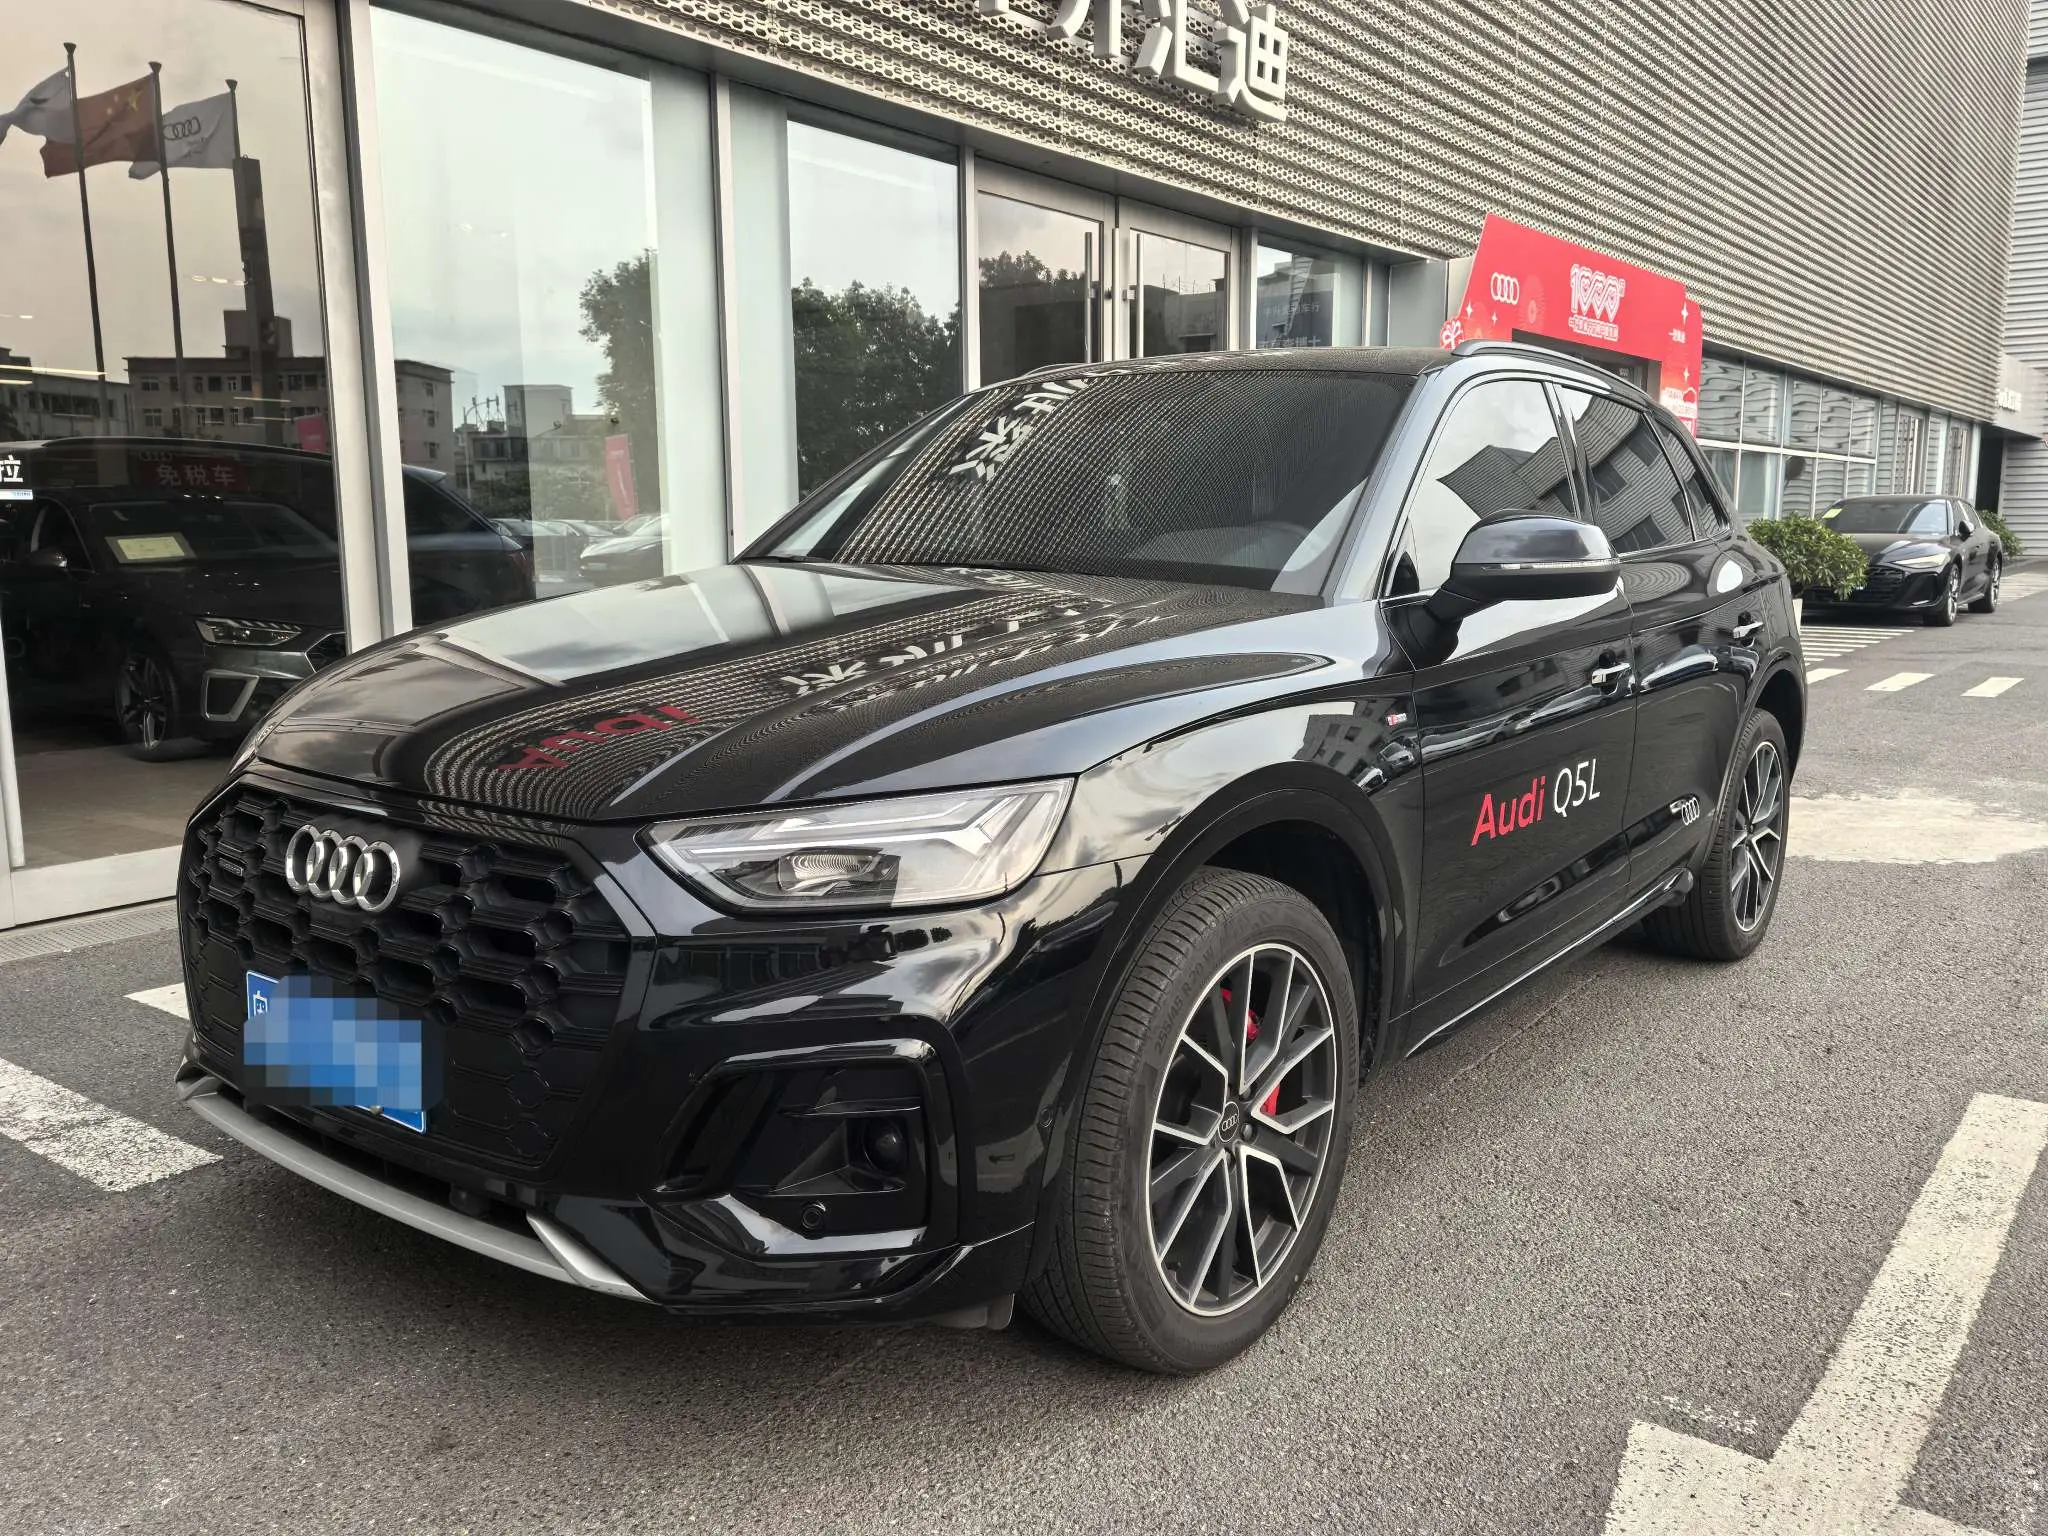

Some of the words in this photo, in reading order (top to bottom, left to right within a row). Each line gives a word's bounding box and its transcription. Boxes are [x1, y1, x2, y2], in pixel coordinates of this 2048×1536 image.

[979, 0, 1288, 122] 汇迪
[157, 464, 236, 487] 免税车
[1471, 776, 1546, 846] Audi
[1554, 759, 1600, 817] Q5L
